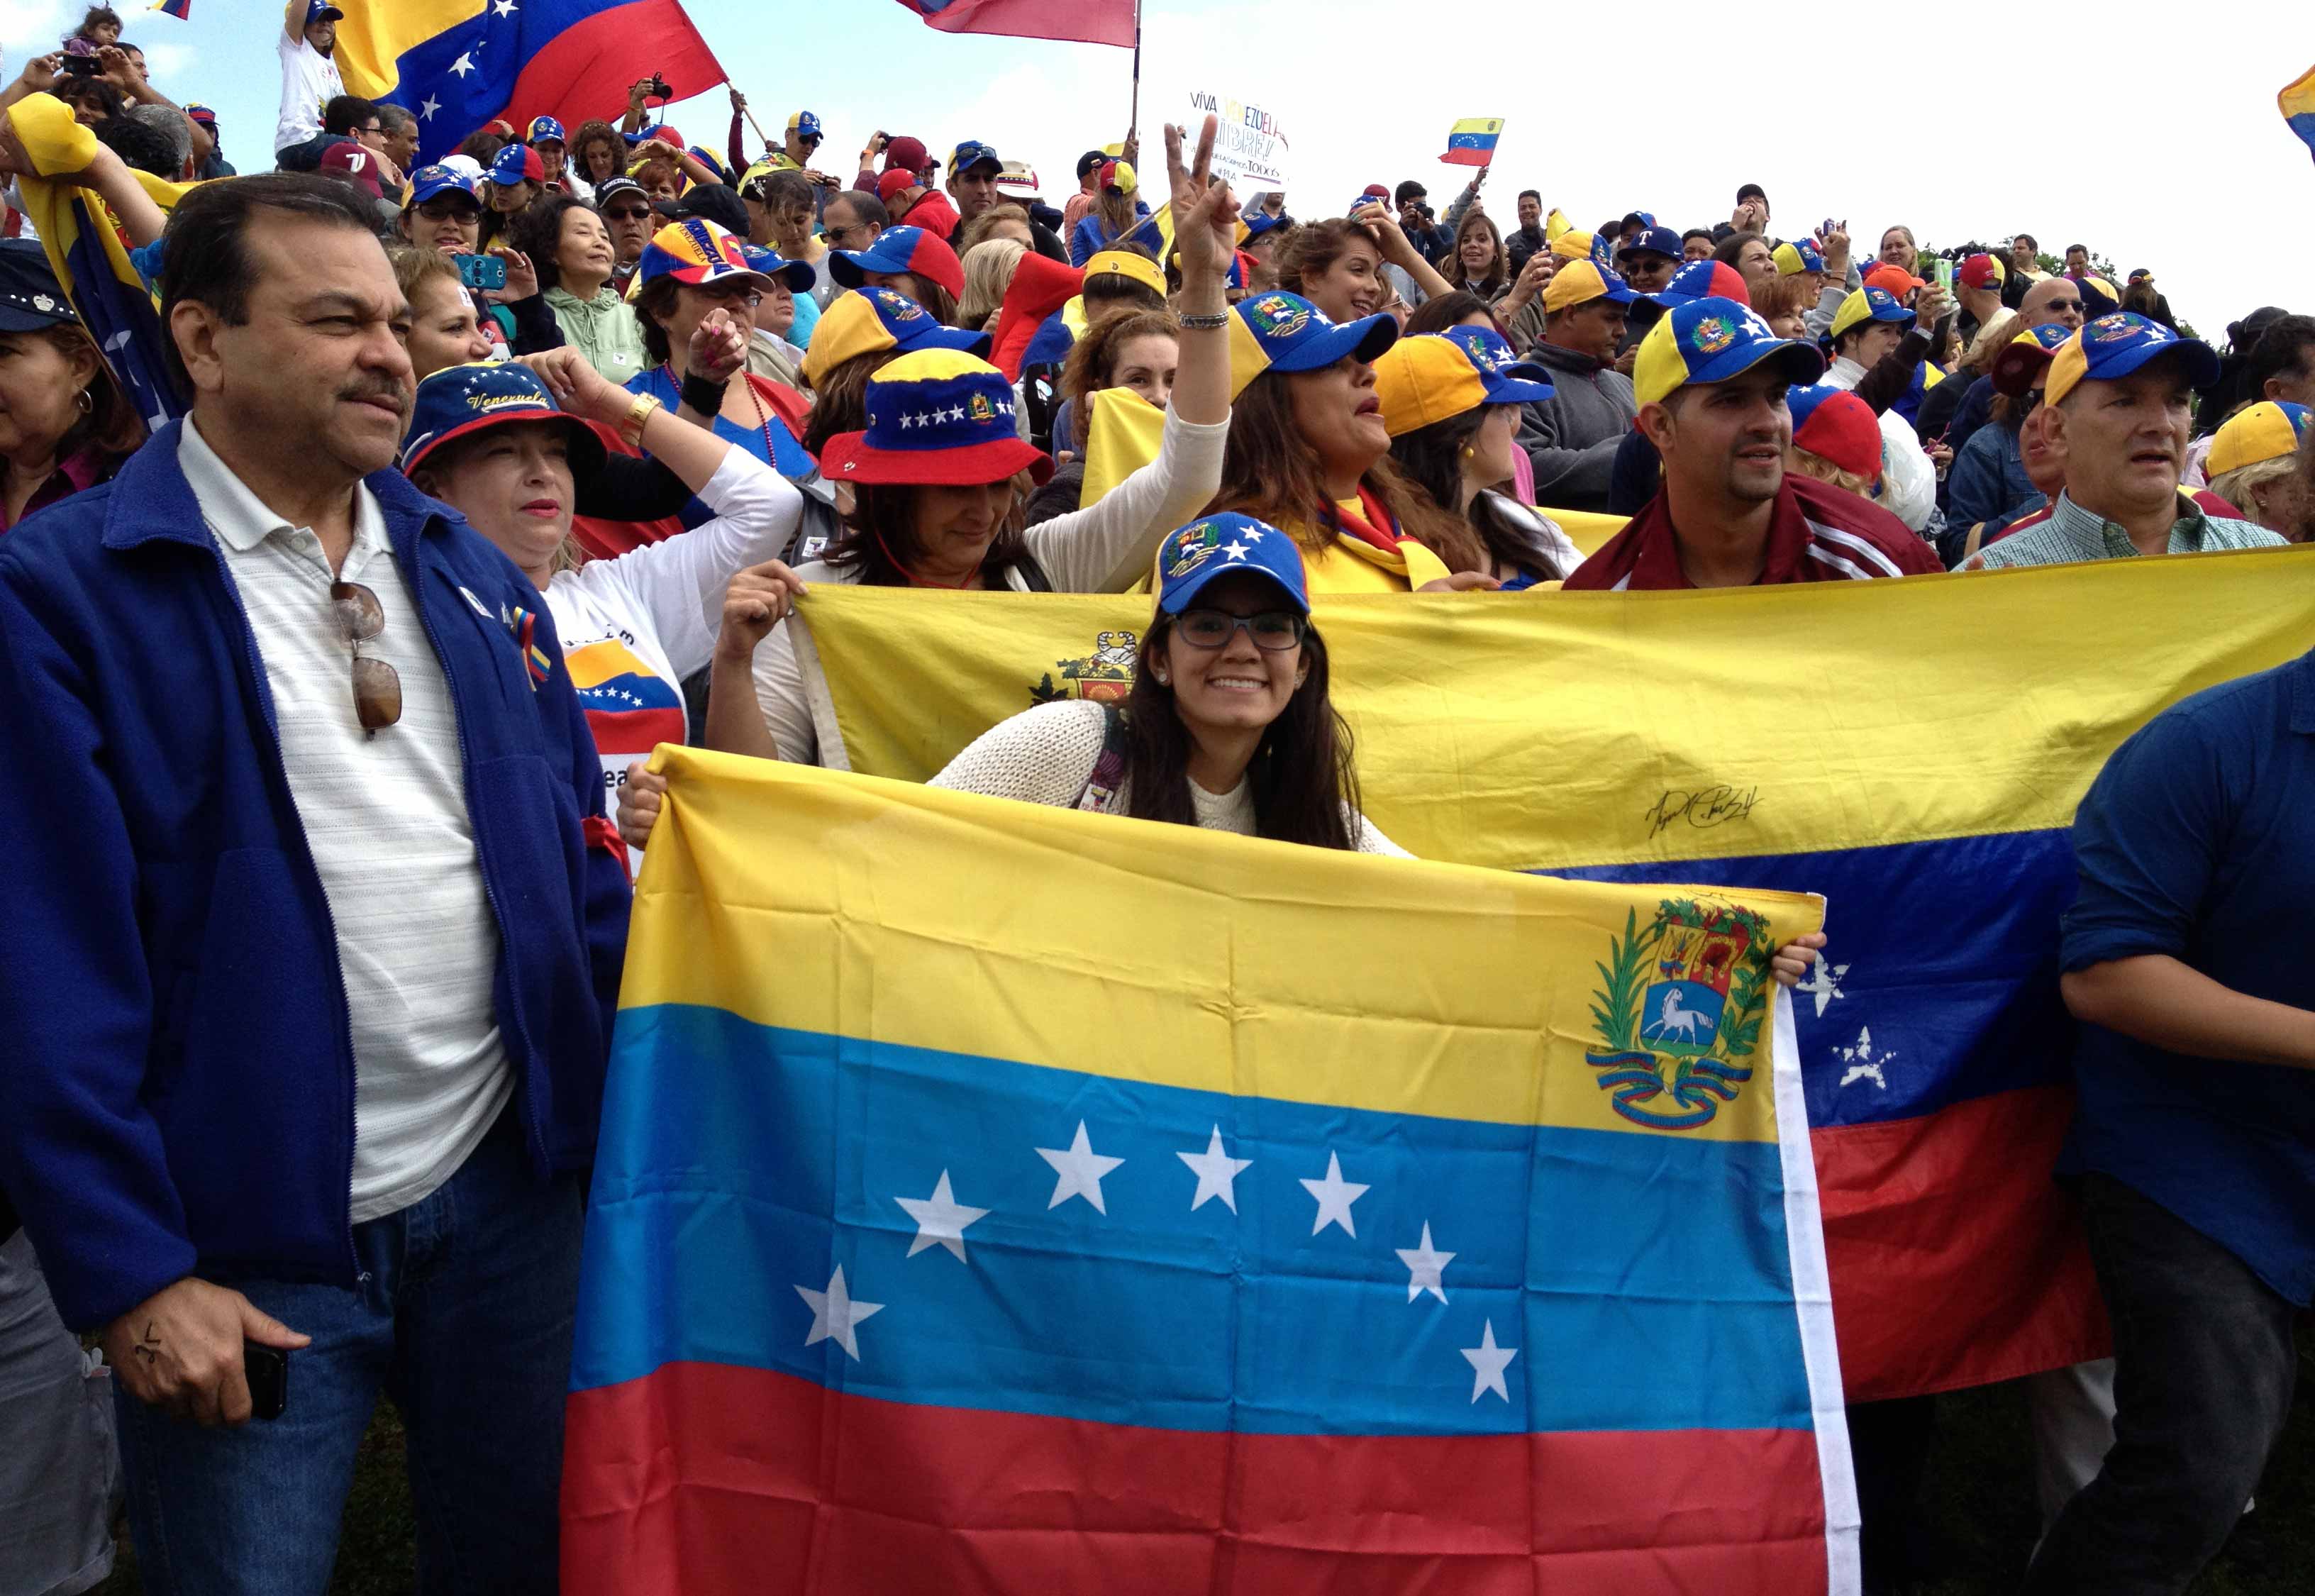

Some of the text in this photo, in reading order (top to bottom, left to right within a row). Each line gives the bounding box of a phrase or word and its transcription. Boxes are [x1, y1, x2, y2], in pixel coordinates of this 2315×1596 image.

[1190, 92, 1217, 113] VIVA
[1214, 118, 1275, 162] IBRE!
[1248, 160, 1279, 177] TODOS
[602, 177, 638, 191] VENEZUELA
[677, 225, 707, 262] VENEZUELA
[1639, 231, 1653, 245] T
[467, 391, 550, 409] Venezuela
